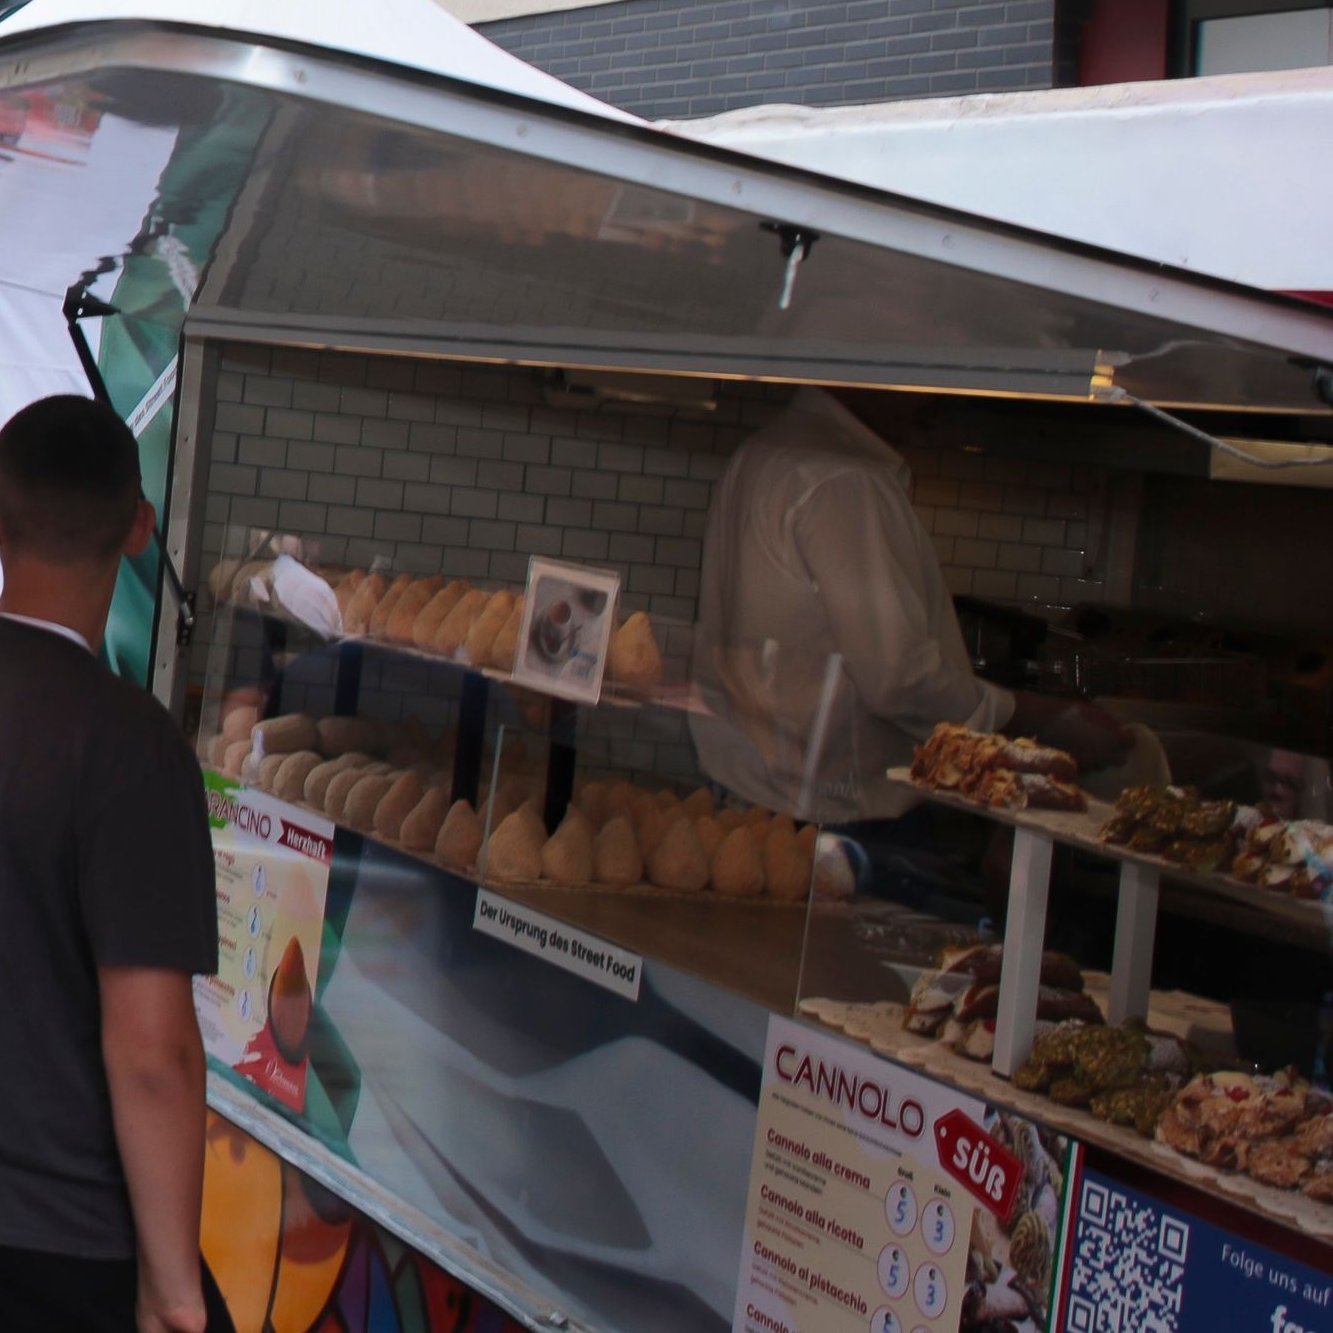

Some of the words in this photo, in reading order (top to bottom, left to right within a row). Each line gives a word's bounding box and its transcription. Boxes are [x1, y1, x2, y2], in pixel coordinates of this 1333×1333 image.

[286, 827, 327, 861] Herzhaft
[480, 900, 497, 921] Der
[499, 908, 548, 948] Ursprung
[549, 930, 569, 953] des
[571, 939, 605, 970] Street
[606, 955, 636, 983] Food
[775, 1044, 925, 1139] CANNOLO
[767, 1127, 811, 1161] Cannolo
[812, 1151, 833, 1171] alla
[834, 1162, 870, 1190] crema
[760, 1184, 803, 1218] Cannolo
[805, 1209, 825, 1229] alla
[826, 1218, 864, 1250] ricotta
[894, 1200, 907, 1224] 5
[753, 1240, 797, 1275] Cannolo
[798, 1266, 809, 1283] al
[809, 1272, 868, 1315] pistacchio
[887, 1263, 899, 1288] 5
[1220, 1243, 1264, 1279] Folge
[1268, 1266, 1297, 1293] uns
[1303, 1282, 1333, 1307] auf
